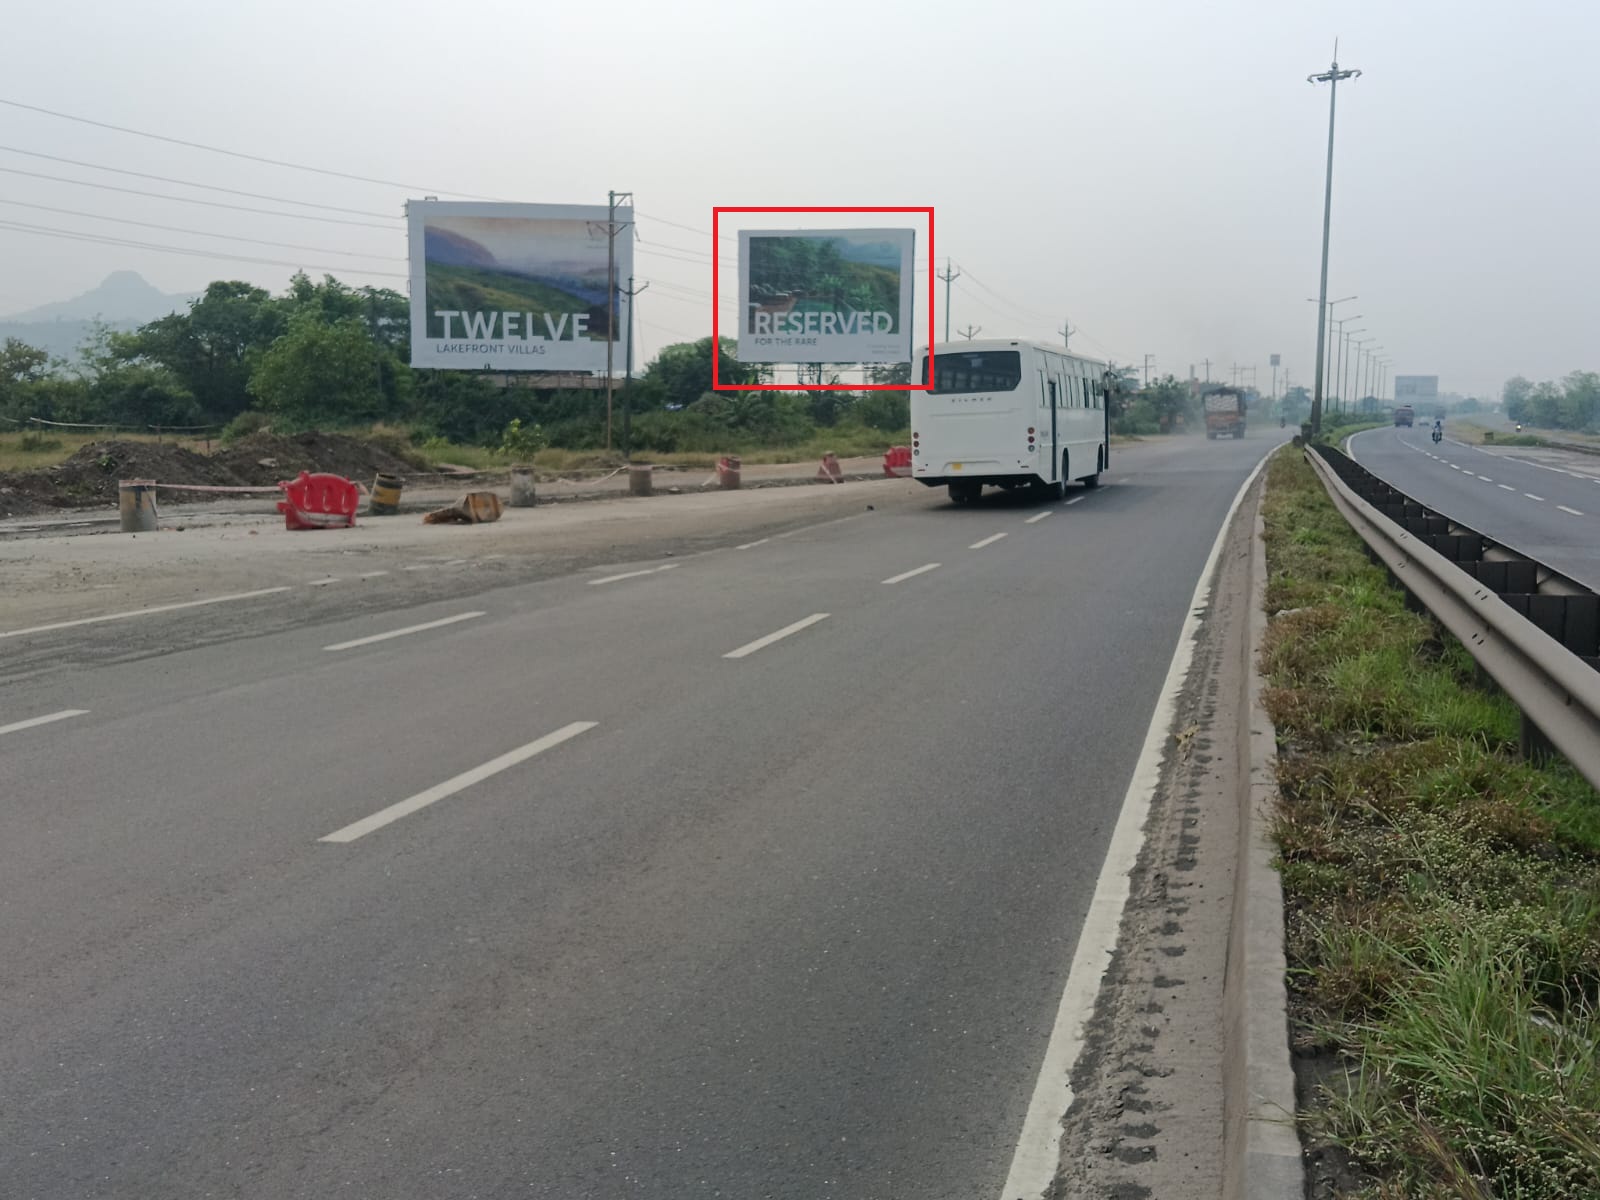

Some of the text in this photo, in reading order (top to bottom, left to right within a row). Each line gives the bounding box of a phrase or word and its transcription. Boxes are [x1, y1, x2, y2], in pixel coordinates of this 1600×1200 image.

[434, 310, 591, 340] TWELVE
[754, 311, 893, 335] RESERVED
[436, 343, 546, 355] LAKEFRONT VILLAS
[754, 338, 817, 347] FOR THE RARE
